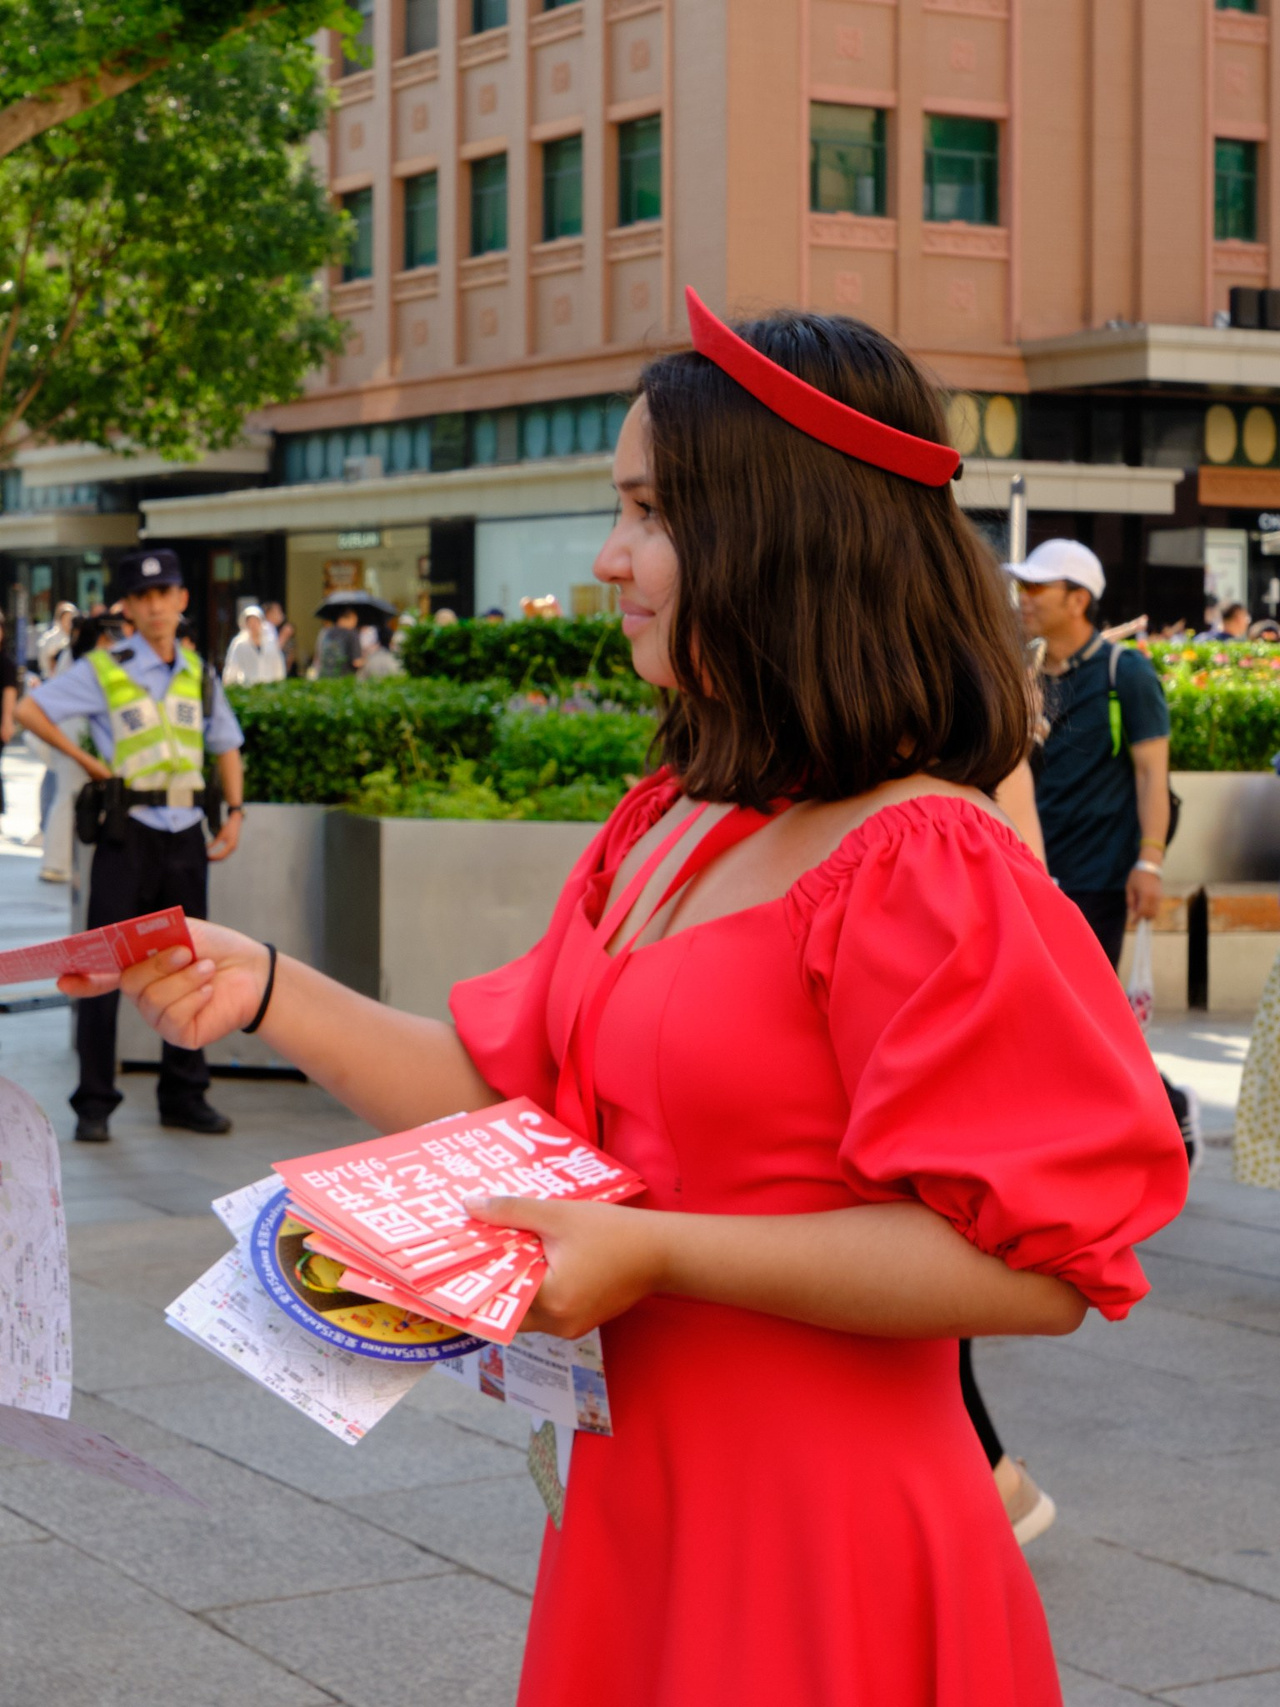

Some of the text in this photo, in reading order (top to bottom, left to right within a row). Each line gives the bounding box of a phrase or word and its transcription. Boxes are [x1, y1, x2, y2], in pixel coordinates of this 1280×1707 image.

[326, 1143, 518, 1212] 印象艺术节
